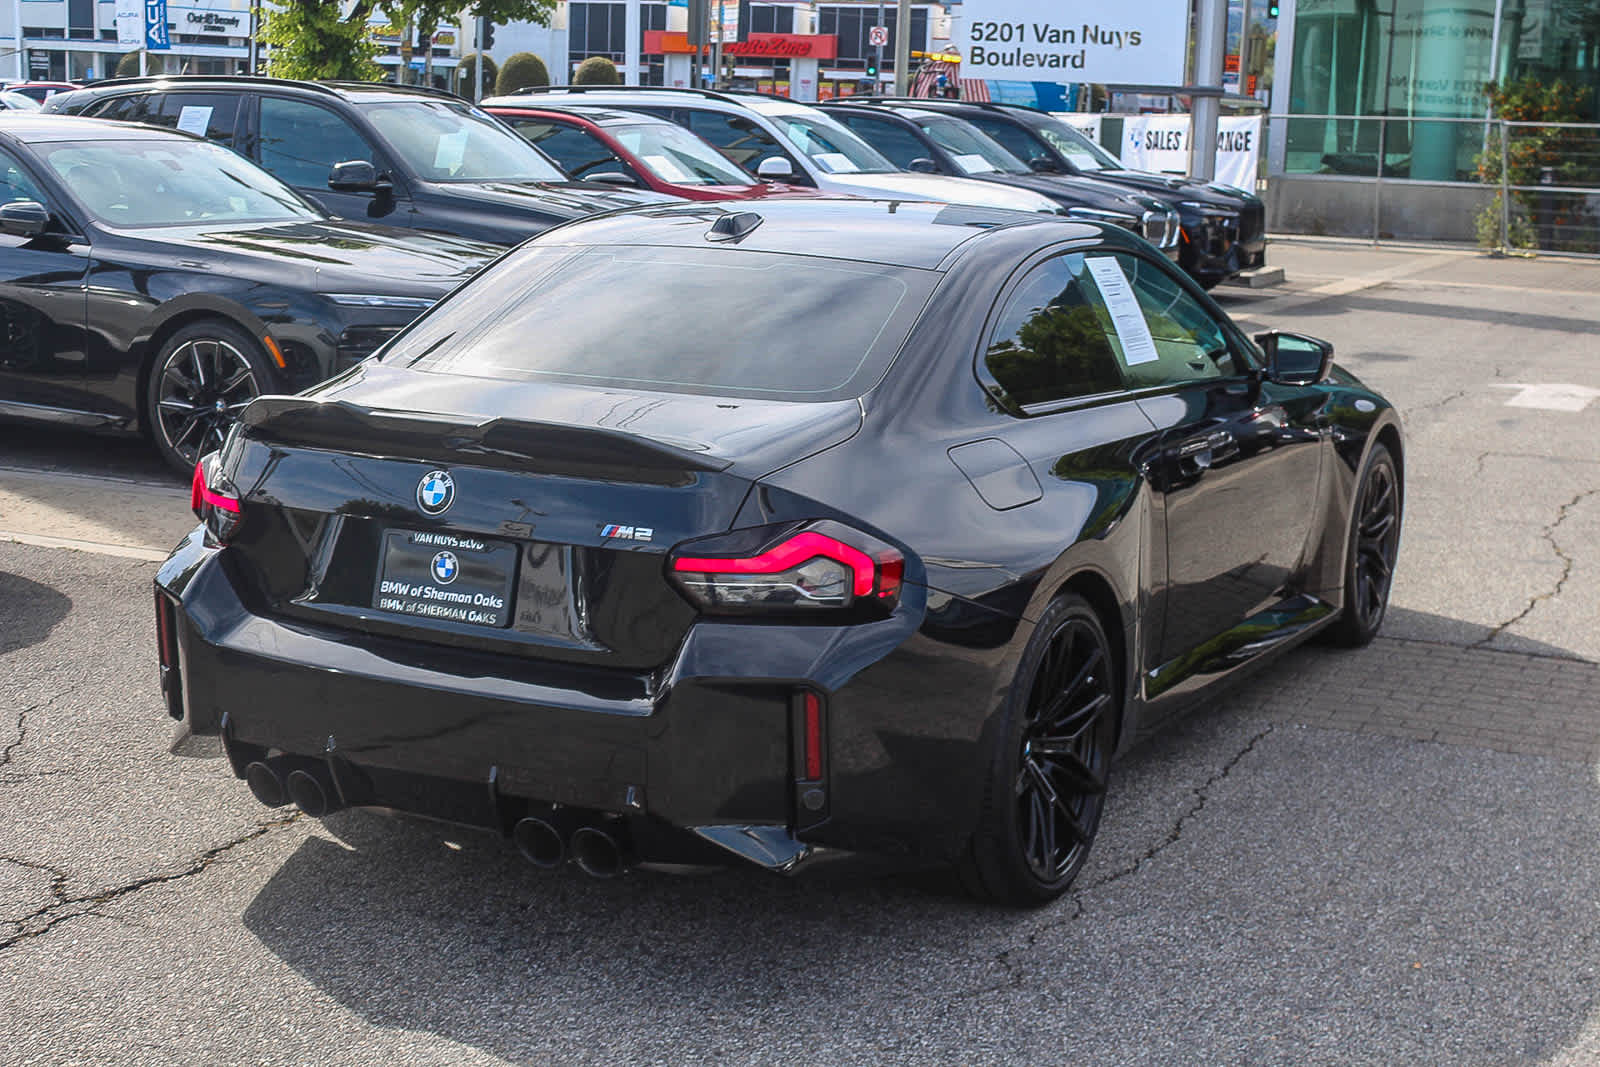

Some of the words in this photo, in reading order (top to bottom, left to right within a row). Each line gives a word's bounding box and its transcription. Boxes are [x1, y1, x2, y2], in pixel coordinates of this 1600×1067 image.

[970, 22, 1025, 43] 5201
[1033, 23, 1075, 44] Van
[1082, 24, 1142, 49] Nuys
[970, 46, 1085, 69] Boulevard
[1145, 130, 1182, 151] SALES
[414, 533, 433, 544] VAN
[433, 534, 458, 547] NUYS
[380, 581, 411, 595] BMW
[410, 585, 423, 597] of
[423, 586, 472, 604] Sherman
[474, 594, 503, 608] Oaks
[380, 598, 406, 611] BMW
[417, 603, 466, 620] SHERMAN
